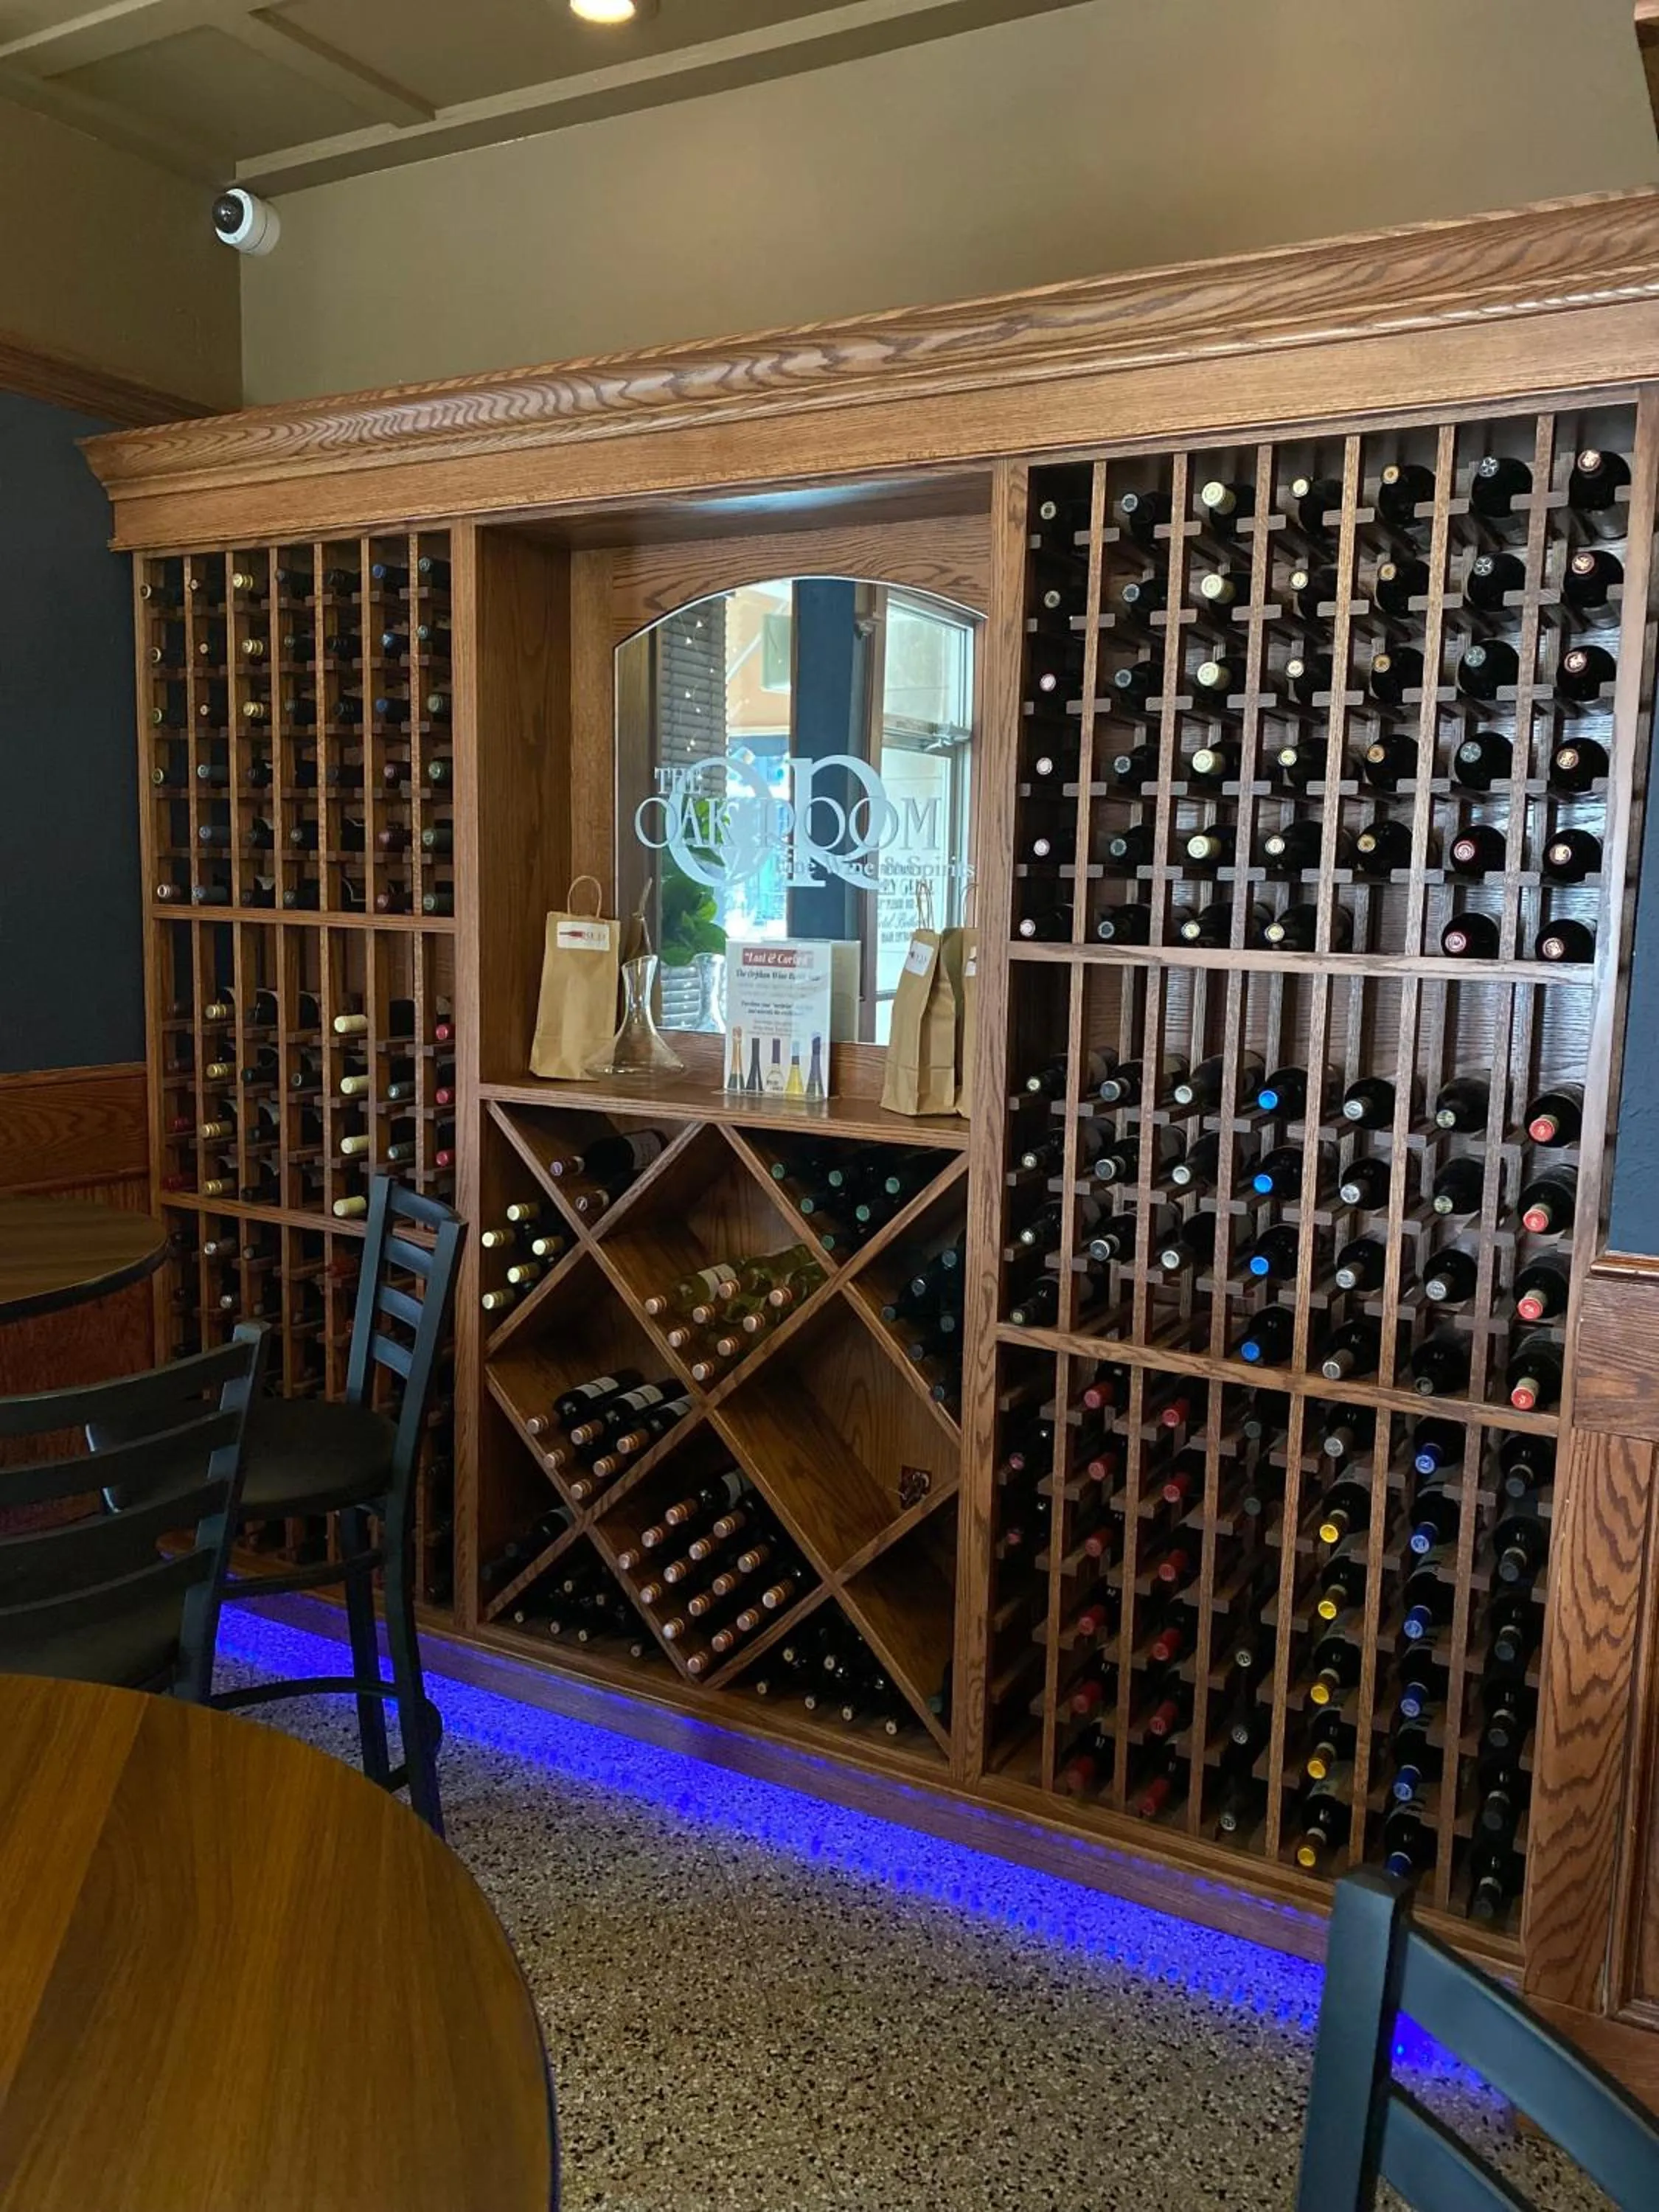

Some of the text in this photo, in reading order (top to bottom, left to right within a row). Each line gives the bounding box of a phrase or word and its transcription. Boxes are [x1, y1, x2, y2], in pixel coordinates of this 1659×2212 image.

[654, 766, 701, 794] THE
[634, 796, 942, 851] OAK ROOM
